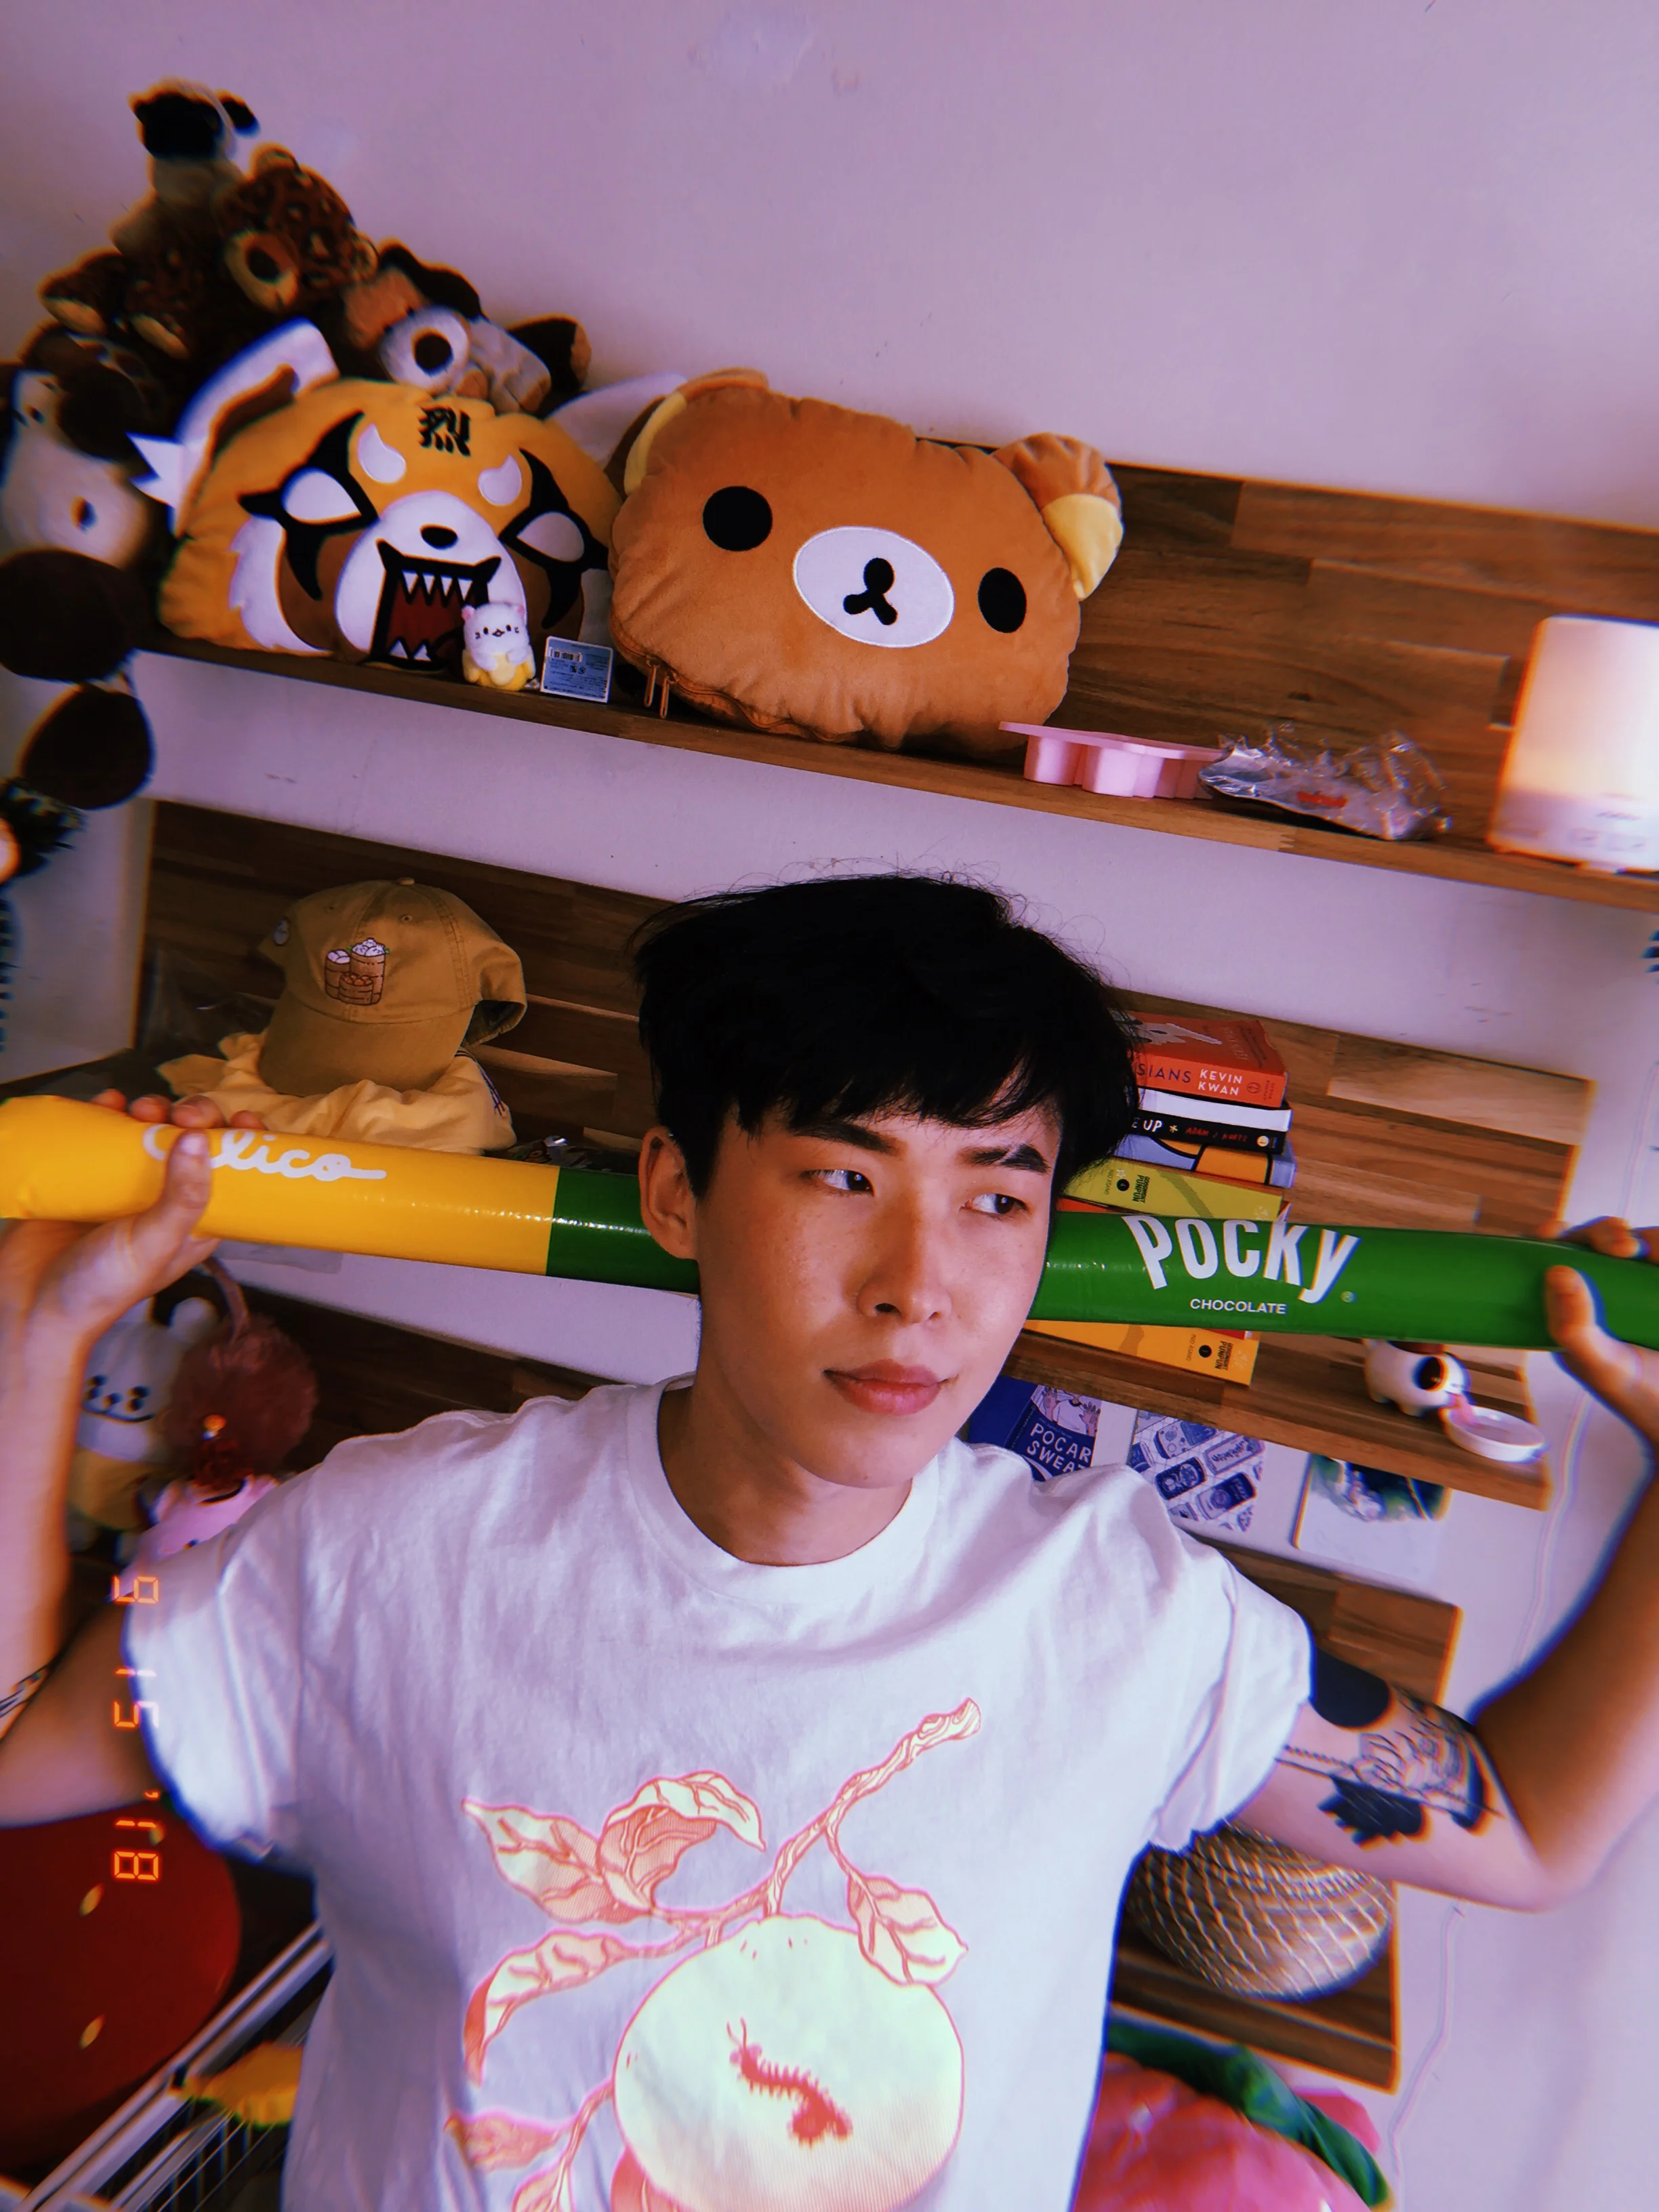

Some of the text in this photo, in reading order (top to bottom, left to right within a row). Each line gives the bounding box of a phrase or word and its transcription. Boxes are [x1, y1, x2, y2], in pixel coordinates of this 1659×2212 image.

[417, 405, 472, 457] 烈
[1136, 1063, 1192, 1084] SIANS
[1200, 1069, 1243, 1084] KEVIN
[1197, 1081, 1240, 1096] KWAN
[1143, 1119, 1164, 1132] UP
[1132, 1174, 1145, 1202] PUNPUN
[1189, 1298, 1288, 1315] CHOCOLATE
[1214, 1340, 1228, 1370] PUNPUN
[1029, 1422, 1092, 1464] POCAR
[1027, 1440, 1086, 1473] SWEA
